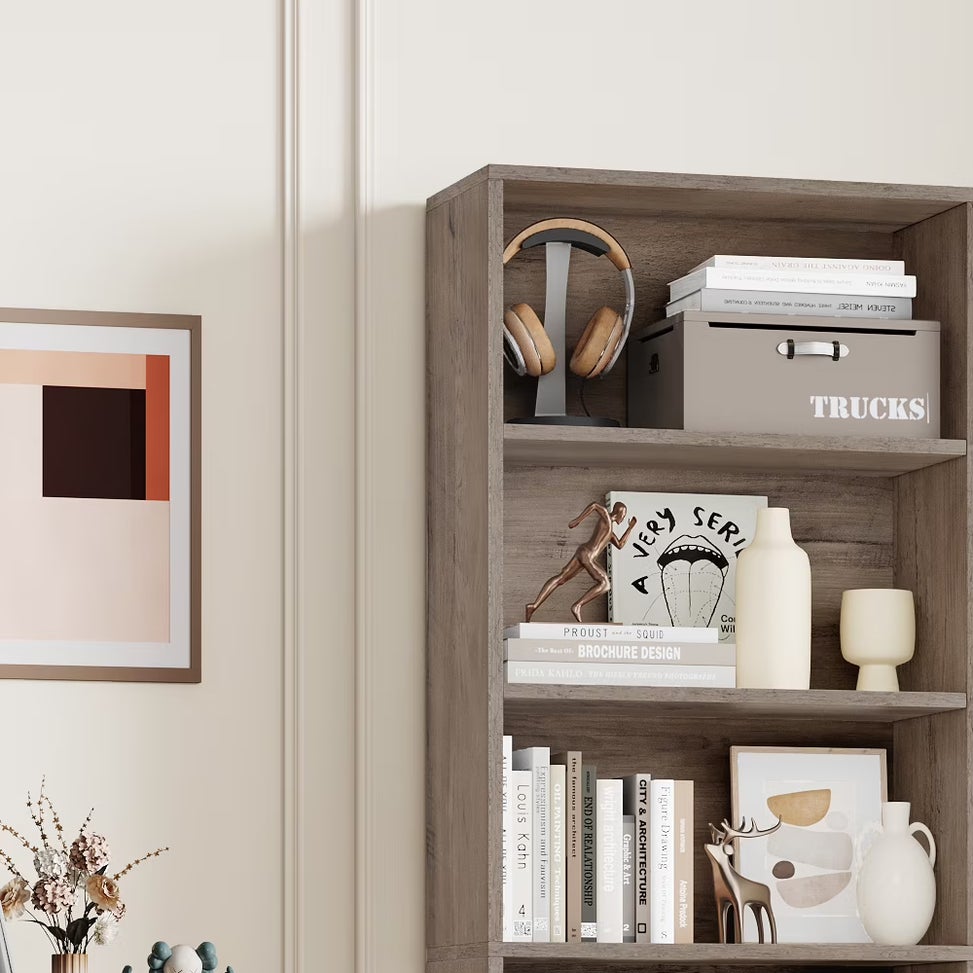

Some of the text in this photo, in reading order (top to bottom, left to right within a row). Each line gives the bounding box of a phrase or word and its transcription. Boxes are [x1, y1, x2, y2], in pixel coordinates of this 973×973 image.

[810, 396, 925, 420] TRUCKS
[633, 507, 676, 559] VERY
[693, 506, 746, 559] SERI
[632, 576, 648, 595] A
[563, 628, 608, 638] PROUST
[636, 629, 665, 640] SQUID
[577, 644, 681, 660] BROCHURE DESIGN
[584, 796, 593, 817] END
[658, 786, 670, 822] Figure
[517, 784, 530, 870] Louis Kahn
[539, 766, 548, 899] Expressionism and Fauvism
[584, 818, 593, 831] OF
[639, 779, 647, 906] CITY & ARCHITECTURE
[552, 784, 562, 922] OIL PAINTING Techniques
[623, 834, 632, 863] Graphic
[658, 825, 670, 870] Drawing
[584, 833, 593, 907] REALATIONSHIP
[623, 872, 632, 885] Art
